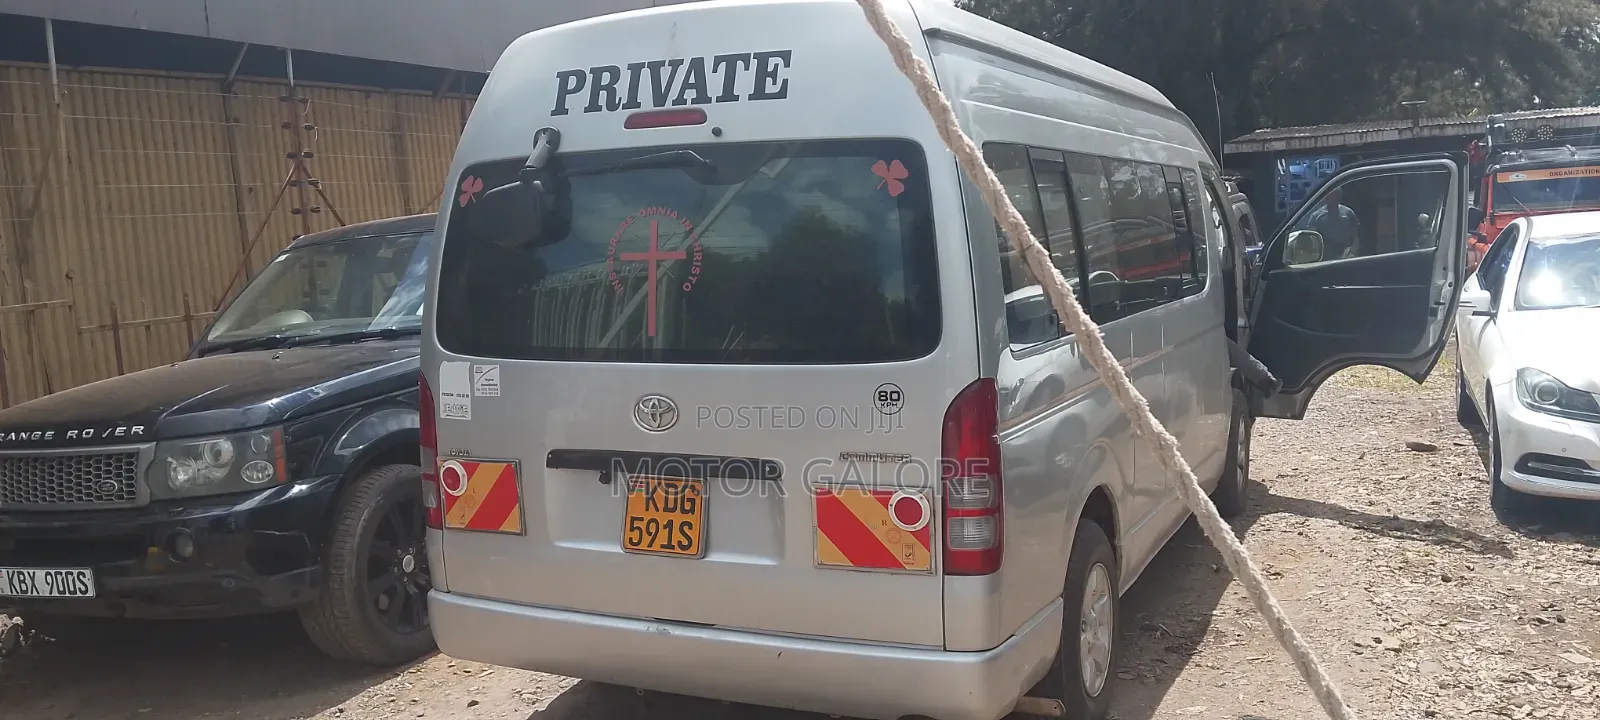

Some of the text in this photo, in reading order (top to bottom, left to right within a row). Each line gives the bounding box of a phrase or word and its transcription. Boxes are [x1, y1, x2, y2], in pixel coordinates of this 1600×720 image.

[550, 49, 792, 116] PRIVATE
[638, 206, 678, 220] OMNIA
[680, 216, 694, 232] IN
[877, 390, 901, 402] 80
[645, 481, 699, 515] KDG
[628, 516, 694, 551] 591S
[7, 570, 89, 595] KBX 900S
